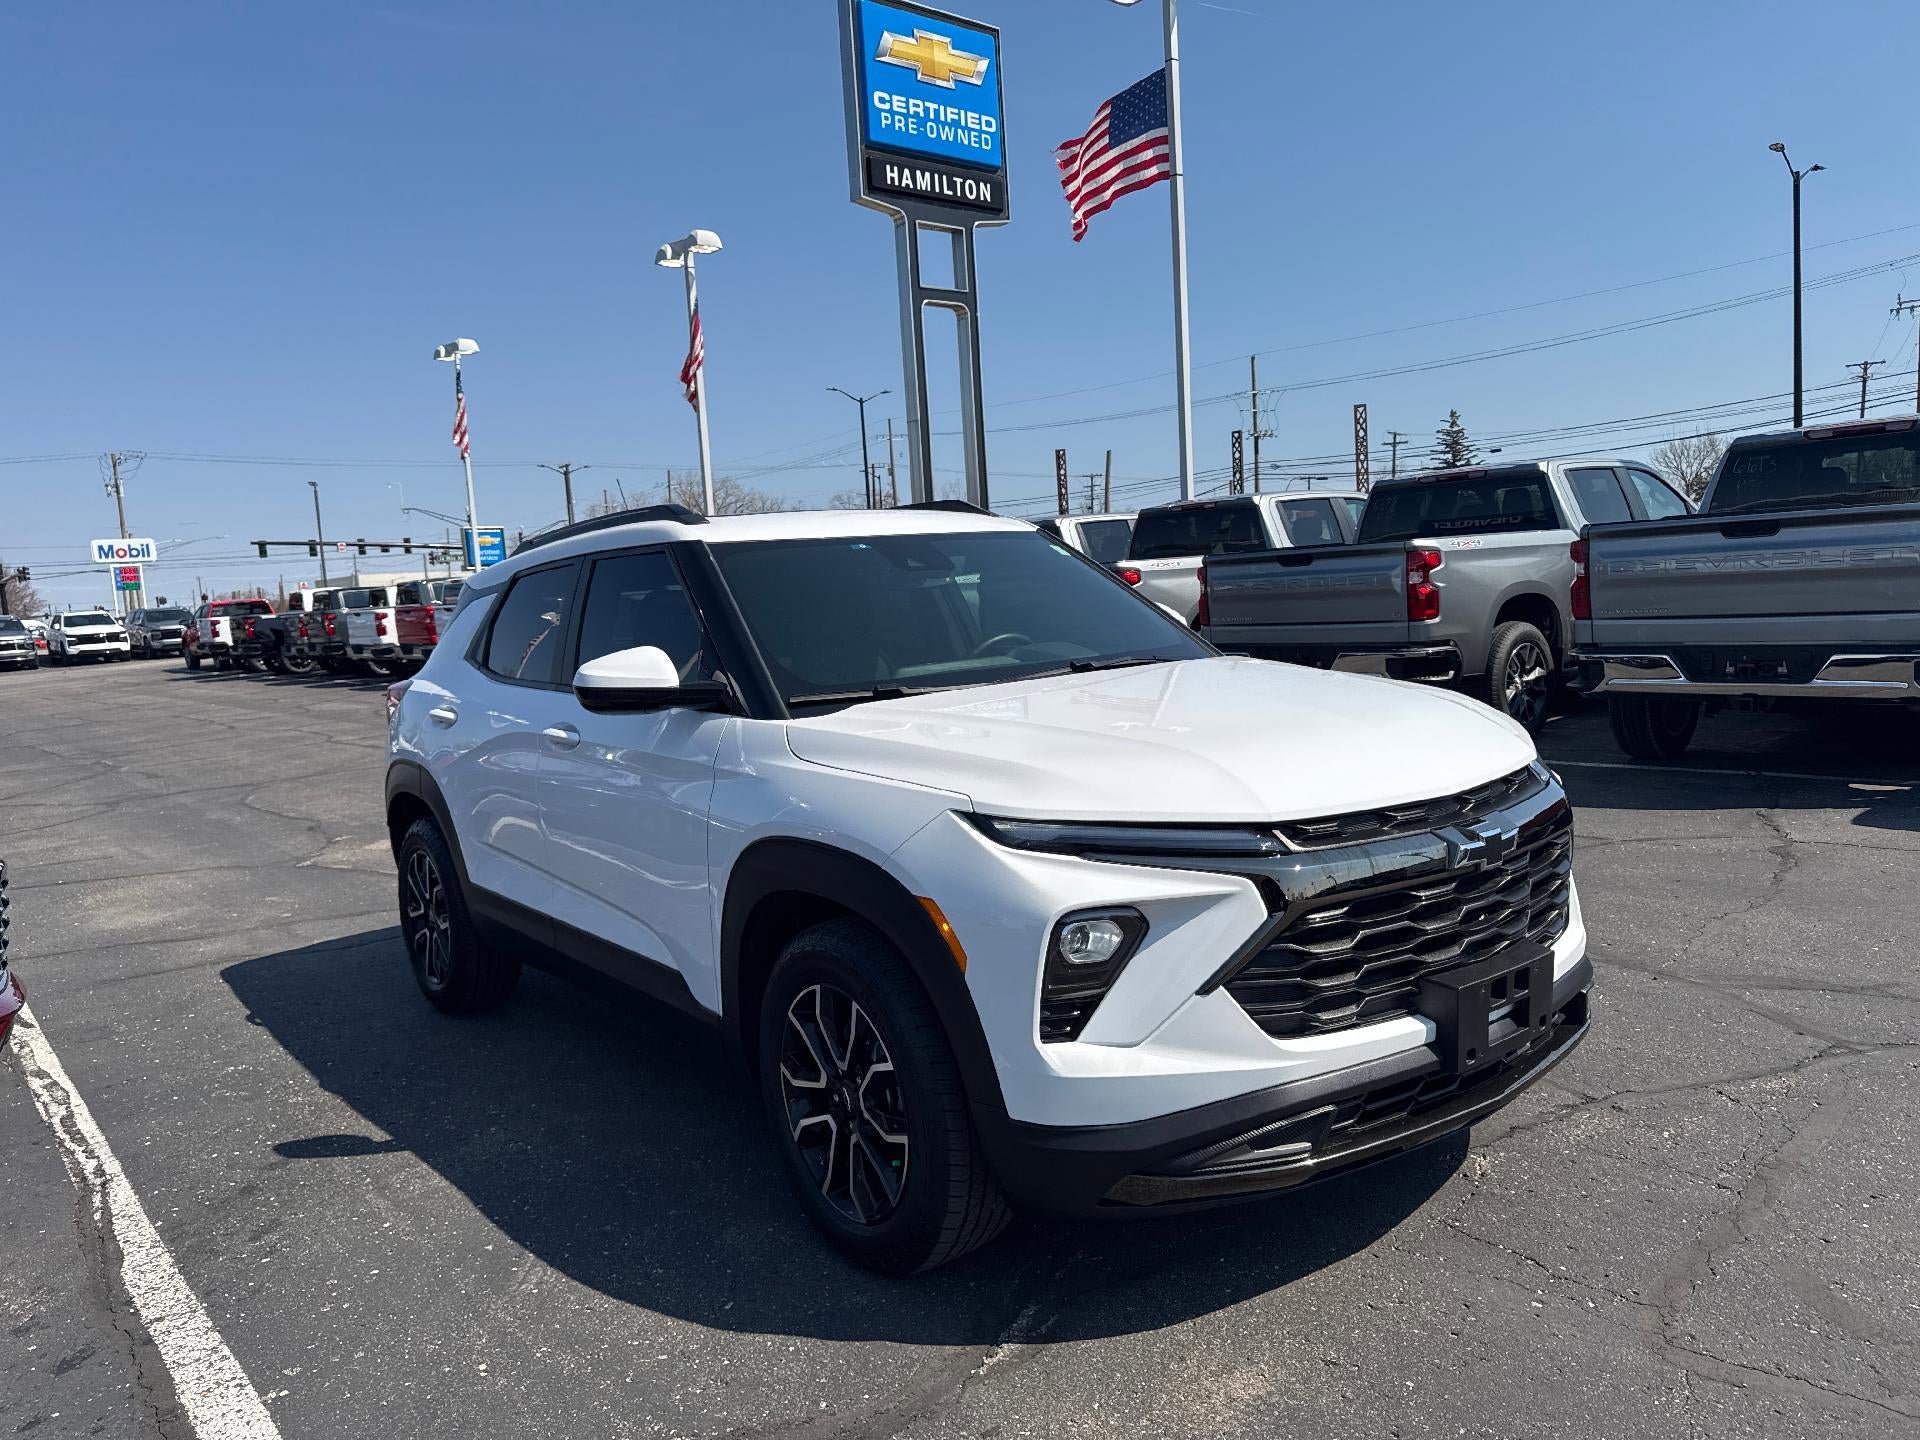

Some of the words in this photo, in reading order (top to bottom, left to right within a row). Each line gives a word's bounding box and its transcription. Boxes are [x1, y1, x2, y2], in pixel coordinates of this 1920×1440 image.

[873, 90, 997, 133] CERTIFIED
[881, 112, 992, 151] PRE-OWNED
[885, 164, 992, 202] HAMILTON
[97, 543, 151, 559] Mobil
